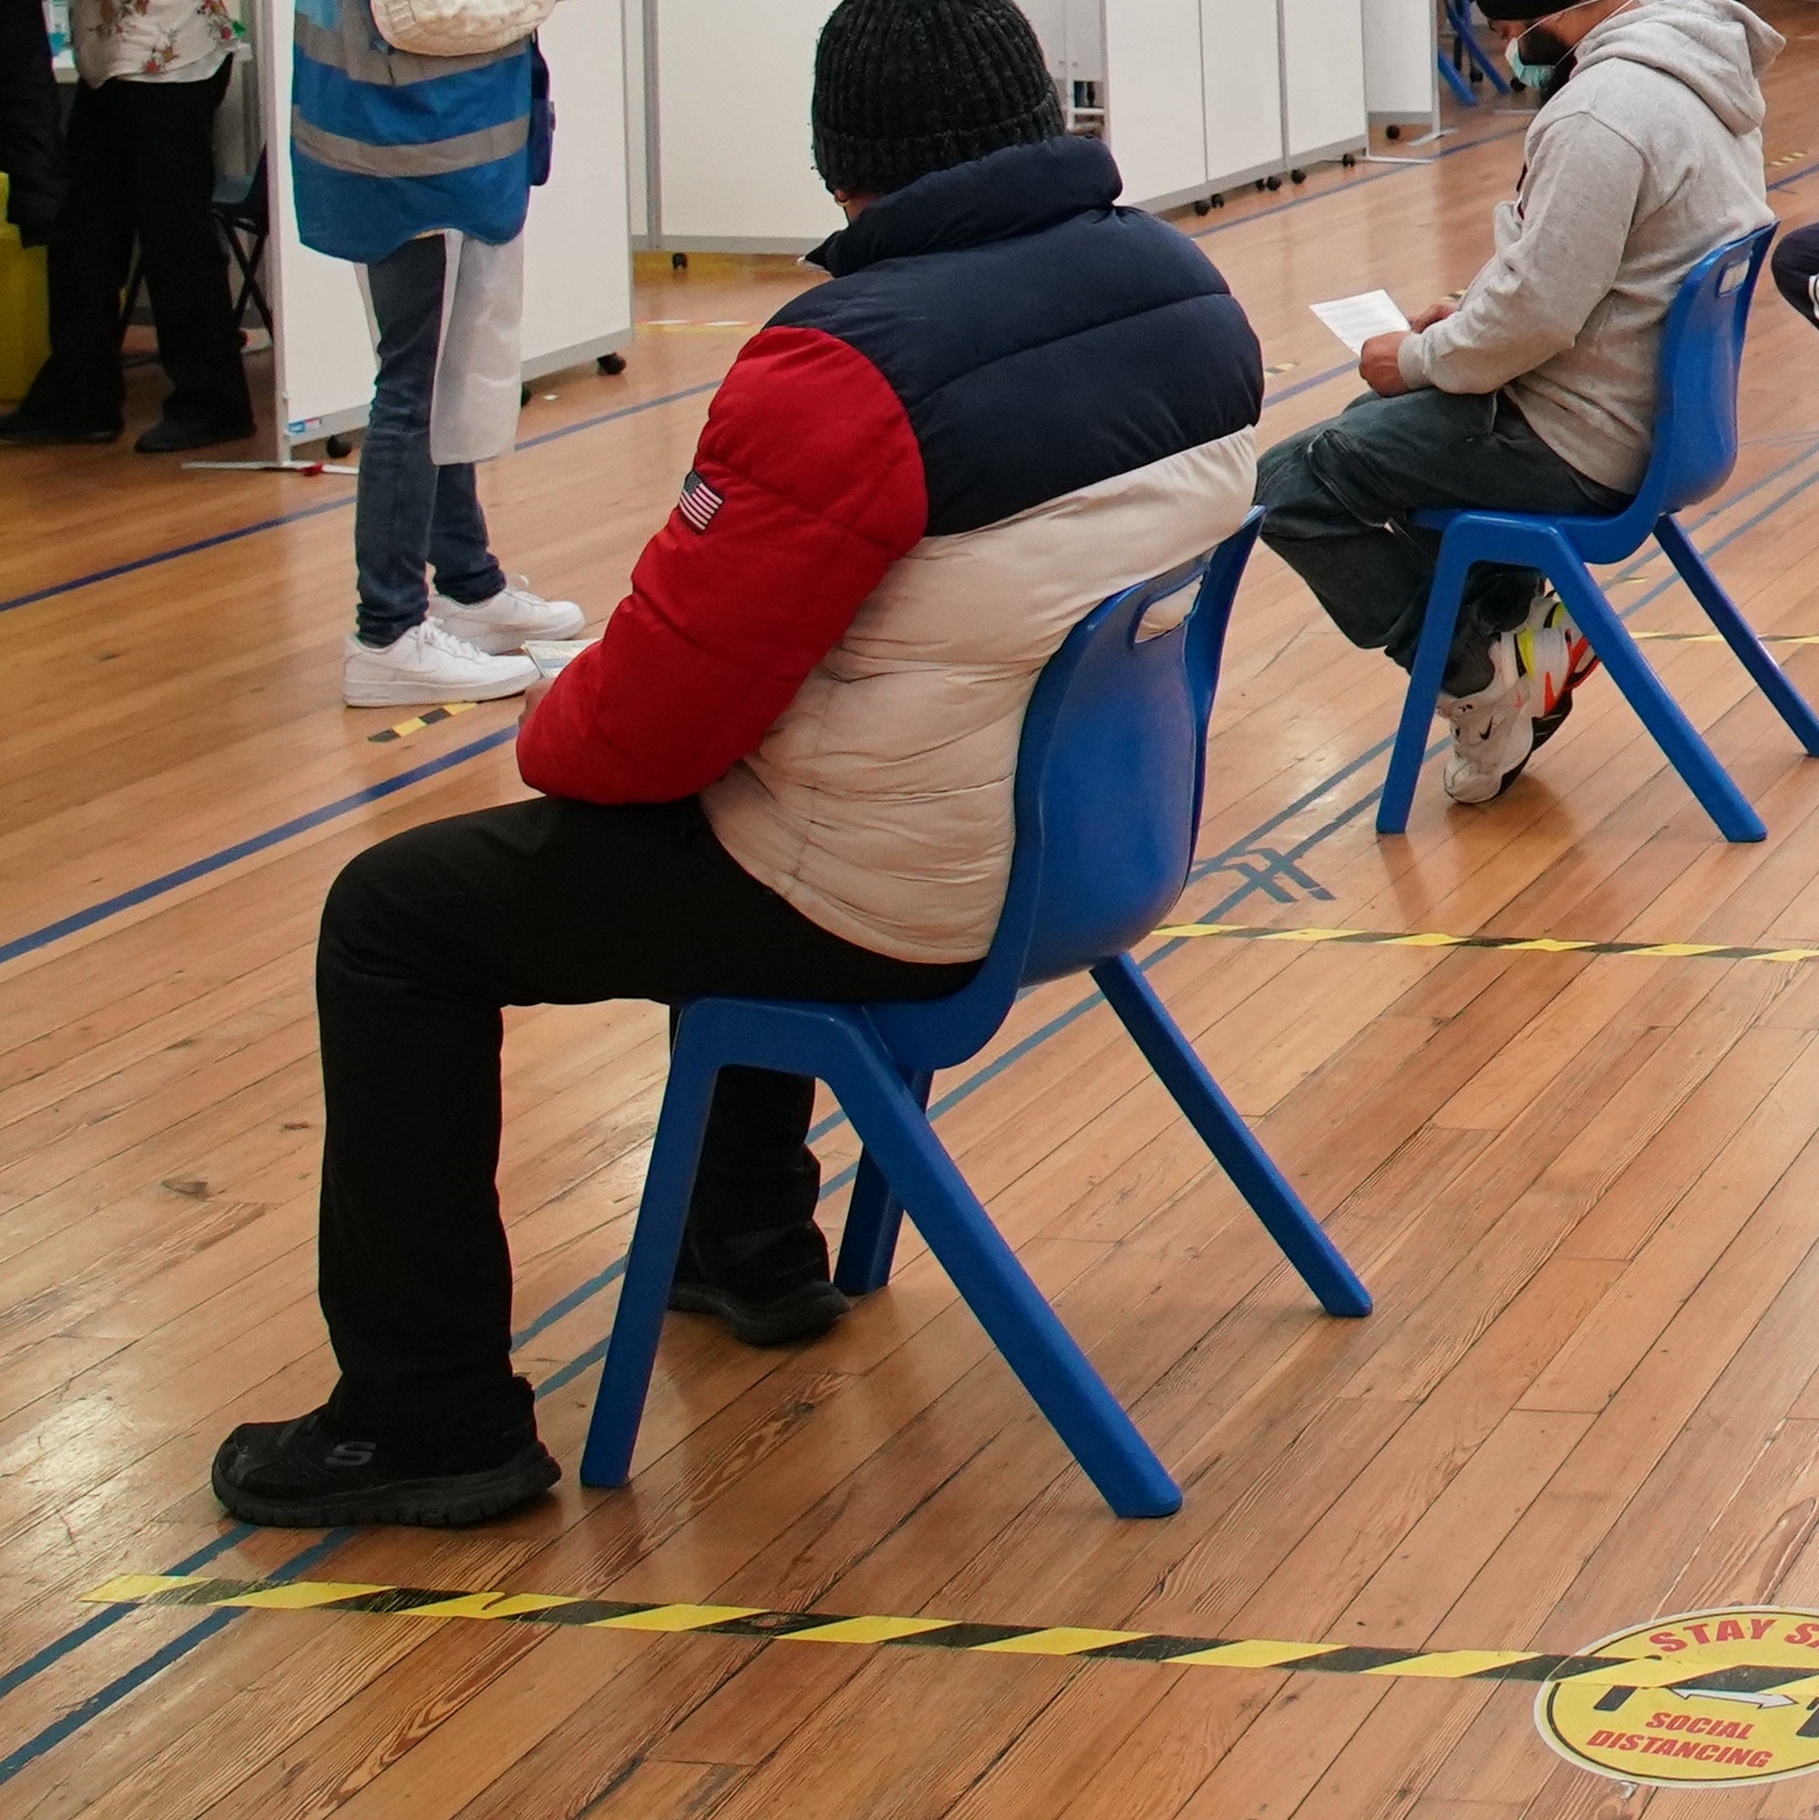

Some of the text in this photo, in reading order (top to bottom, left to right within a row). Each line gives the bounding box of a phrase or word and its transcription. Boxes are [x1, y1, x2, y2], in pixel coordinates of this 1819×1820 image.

[1649, 1618, 1778, 1653] STAY
[1645, 1711, 1755, 1740] SOCIAL
[1586, 1730, 1774, 1768] DISTANCING
